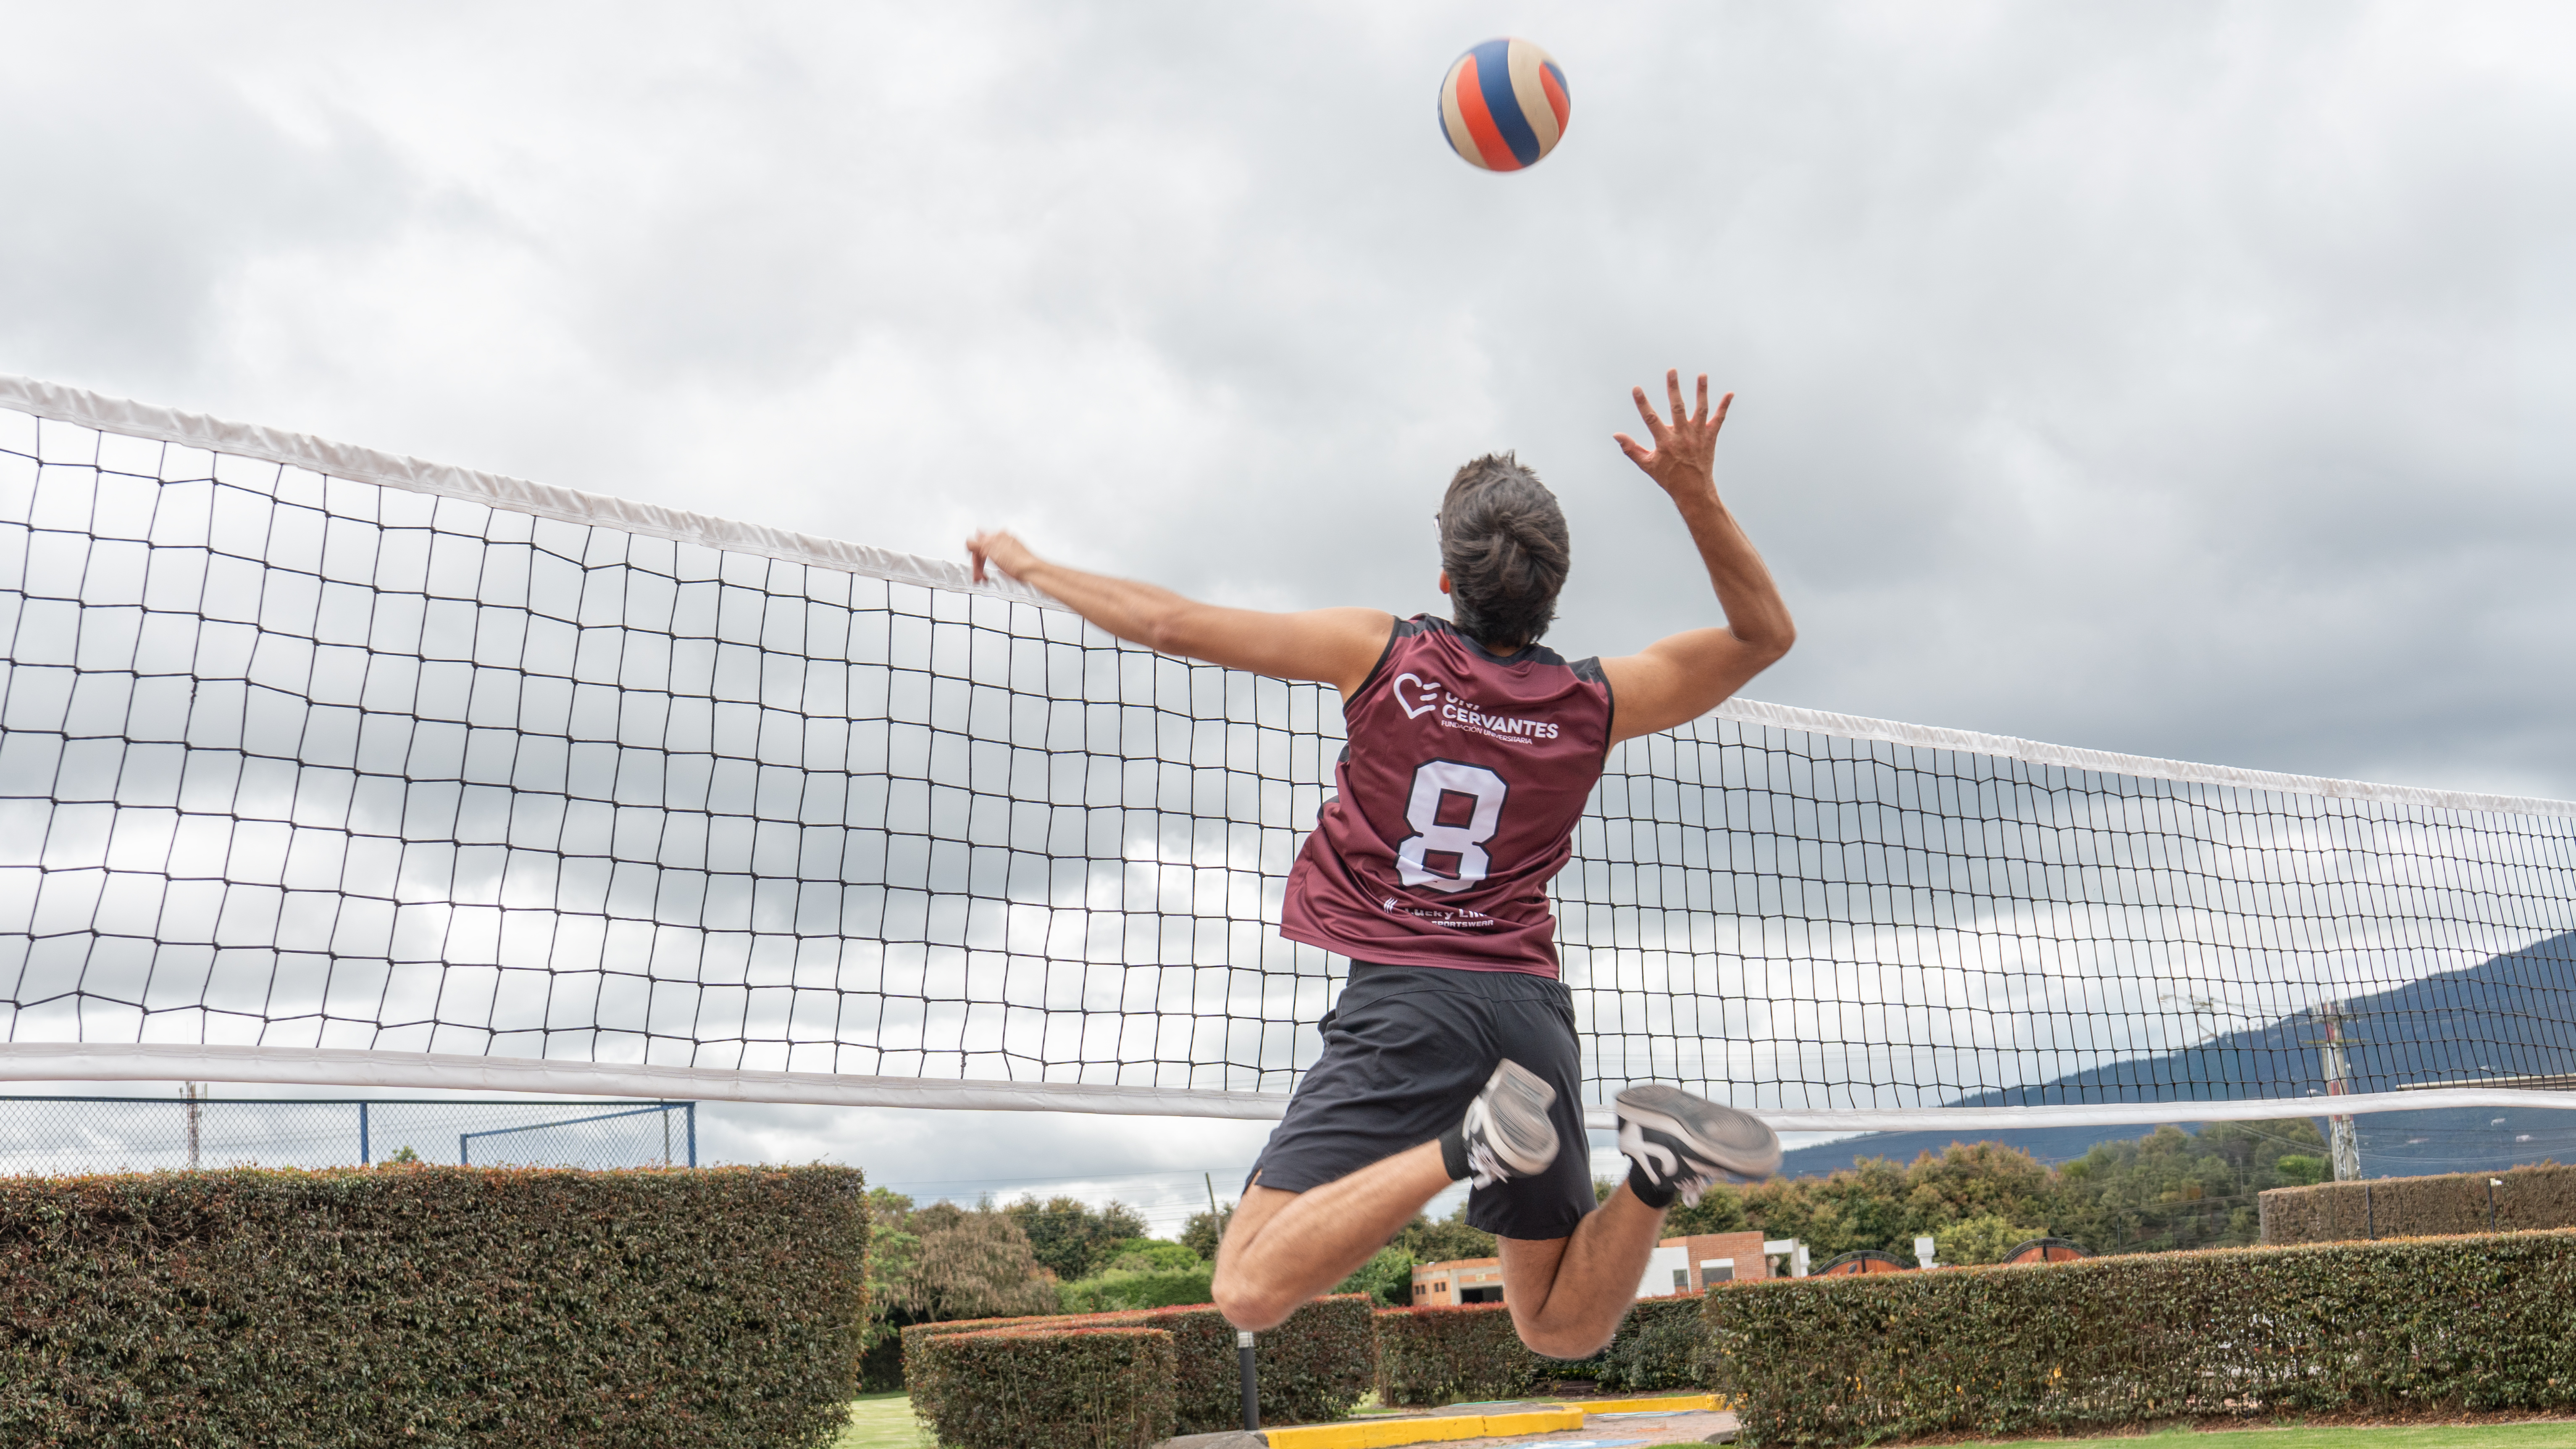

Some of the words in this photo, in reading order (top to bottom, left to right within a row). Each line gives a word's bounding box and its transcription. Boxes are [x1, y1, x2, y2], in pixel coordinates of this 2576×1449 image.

[1442, 704, 1559, 739] CERVANTES
[1483, 729, 1532, 745] UNIVERSITARIA
[1394, 757, 1510, 894] 8
